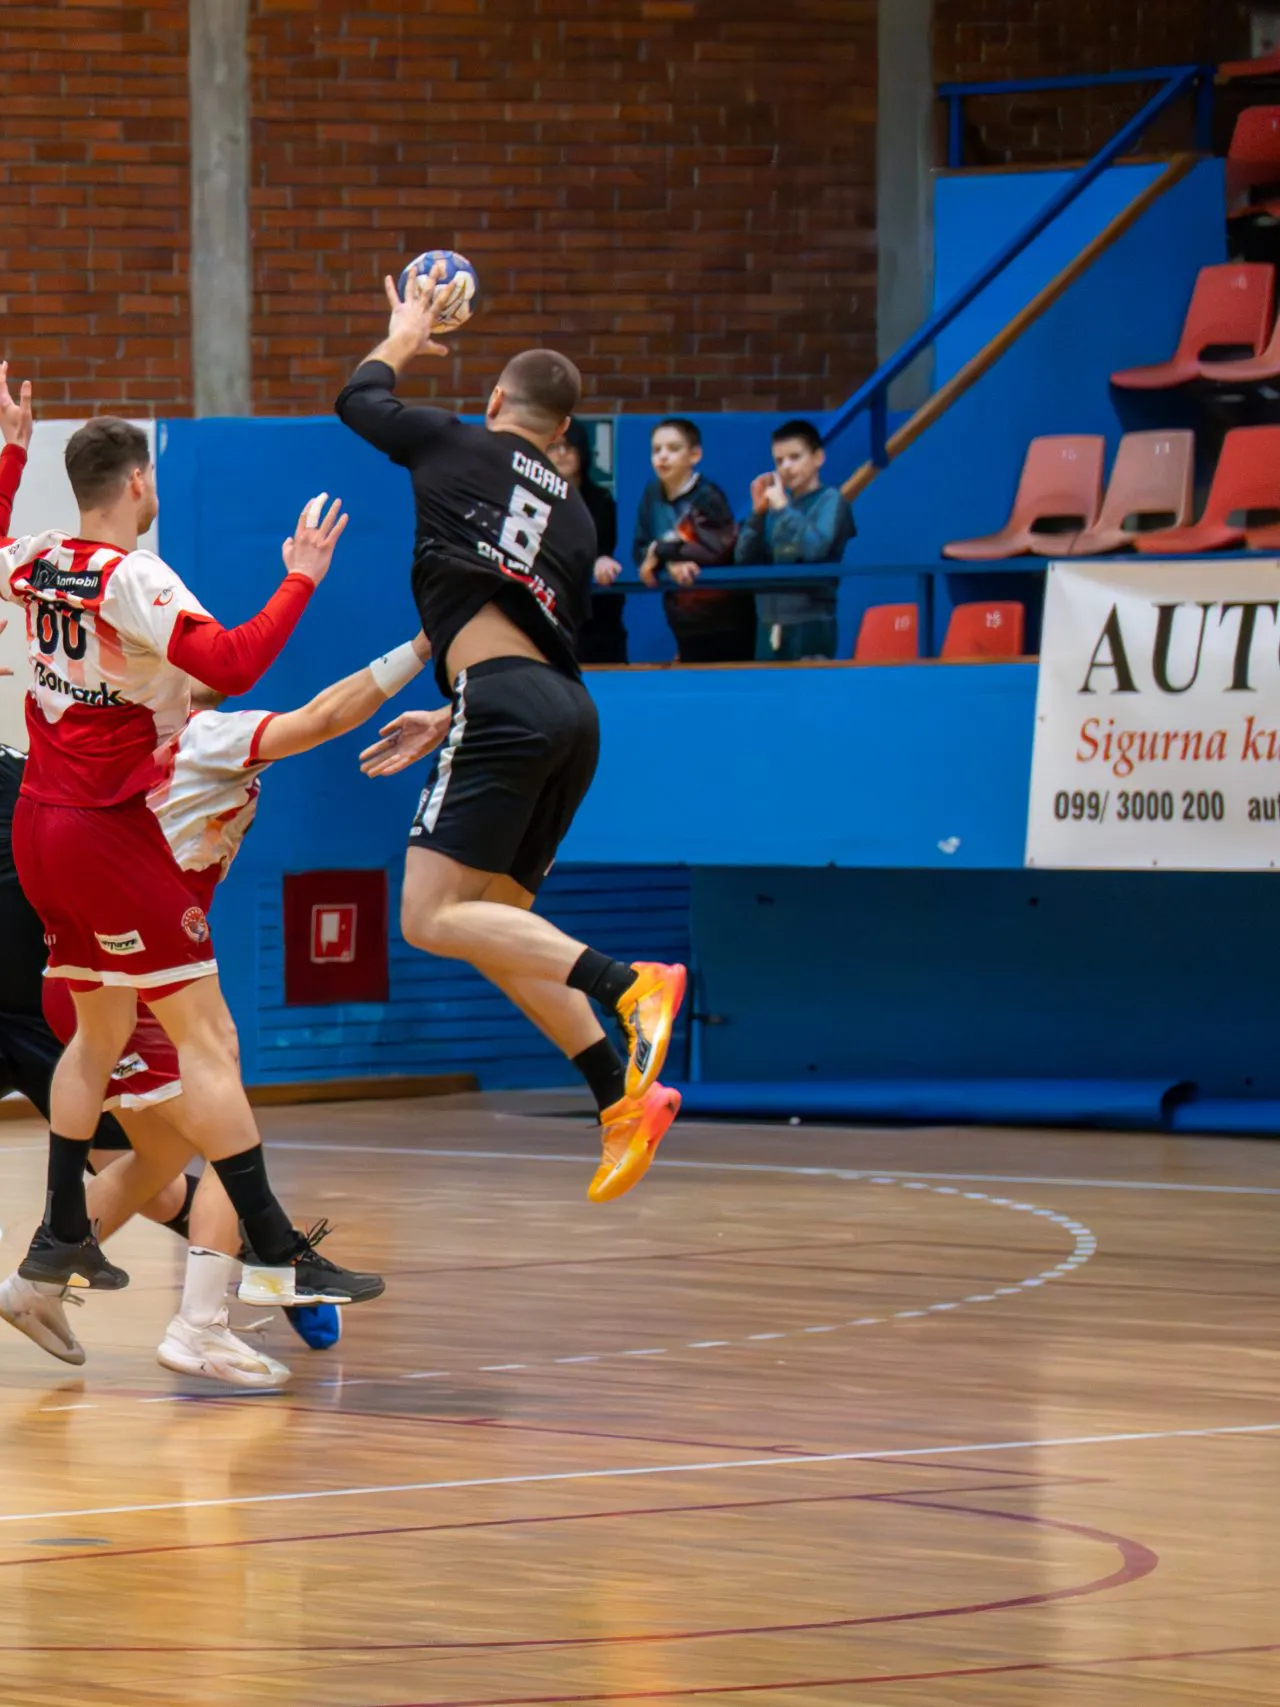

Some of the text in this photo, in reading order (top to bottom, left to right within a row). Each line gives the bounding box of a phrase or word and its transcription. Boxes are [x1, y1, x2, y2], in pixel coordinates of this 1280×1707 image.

[498, 484, 552, 569] 8
[1077, 600, 1280, 694] AUT
[1076, 717, 1229, 778] Sigurna
[1054, 790, 1110, 824] 099/
[1116, 790, 1174, 821] 3000
[1182, 790, 1225, 821] 200
